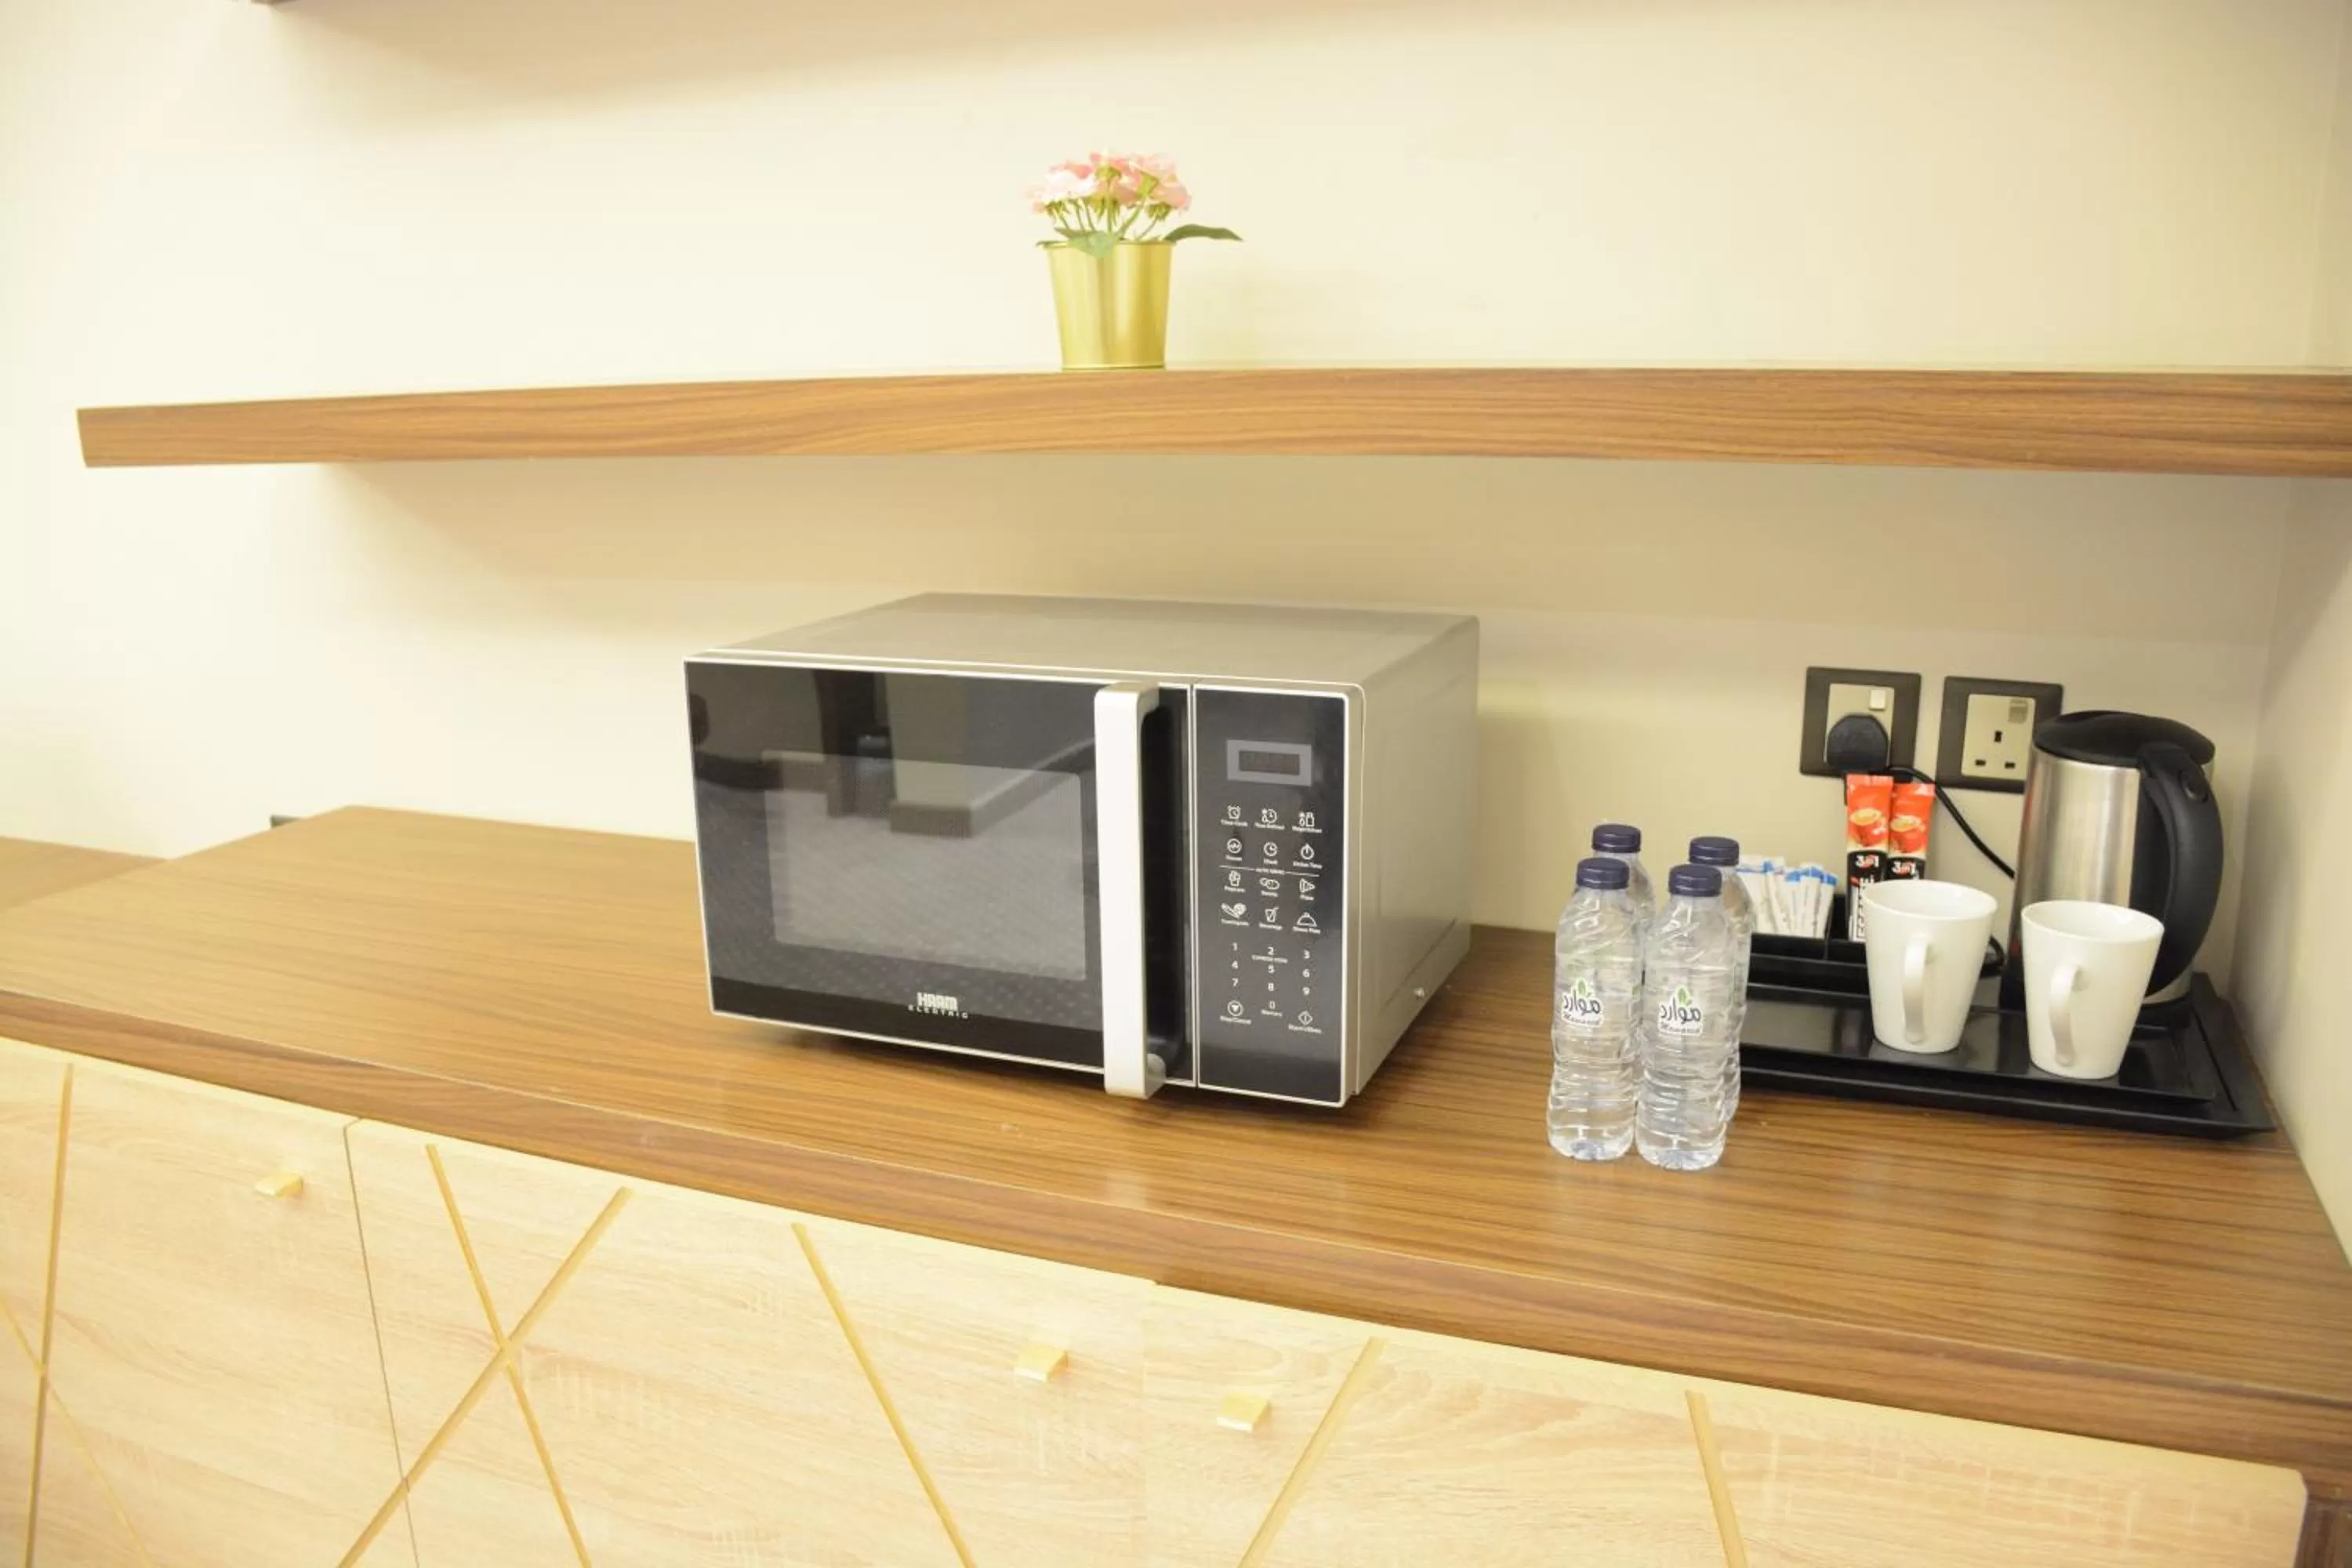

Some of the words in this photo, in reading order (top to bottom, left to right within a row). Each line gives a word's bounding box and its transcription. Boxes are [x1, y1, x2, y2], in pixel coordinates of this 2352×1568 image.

[1231, 942, 1238, 951] 1
[1268, 946, 1274, 956] 2
[1303, 949, 1311, 960] 3
[1231, 960, 1239, 970] 4
[1268, 964, 1275, 974] 5
[1302, 968, 1310, 978] 6
[1232, 978, 1239, 987] 7
[1302, 987, 1310, 996] 9
